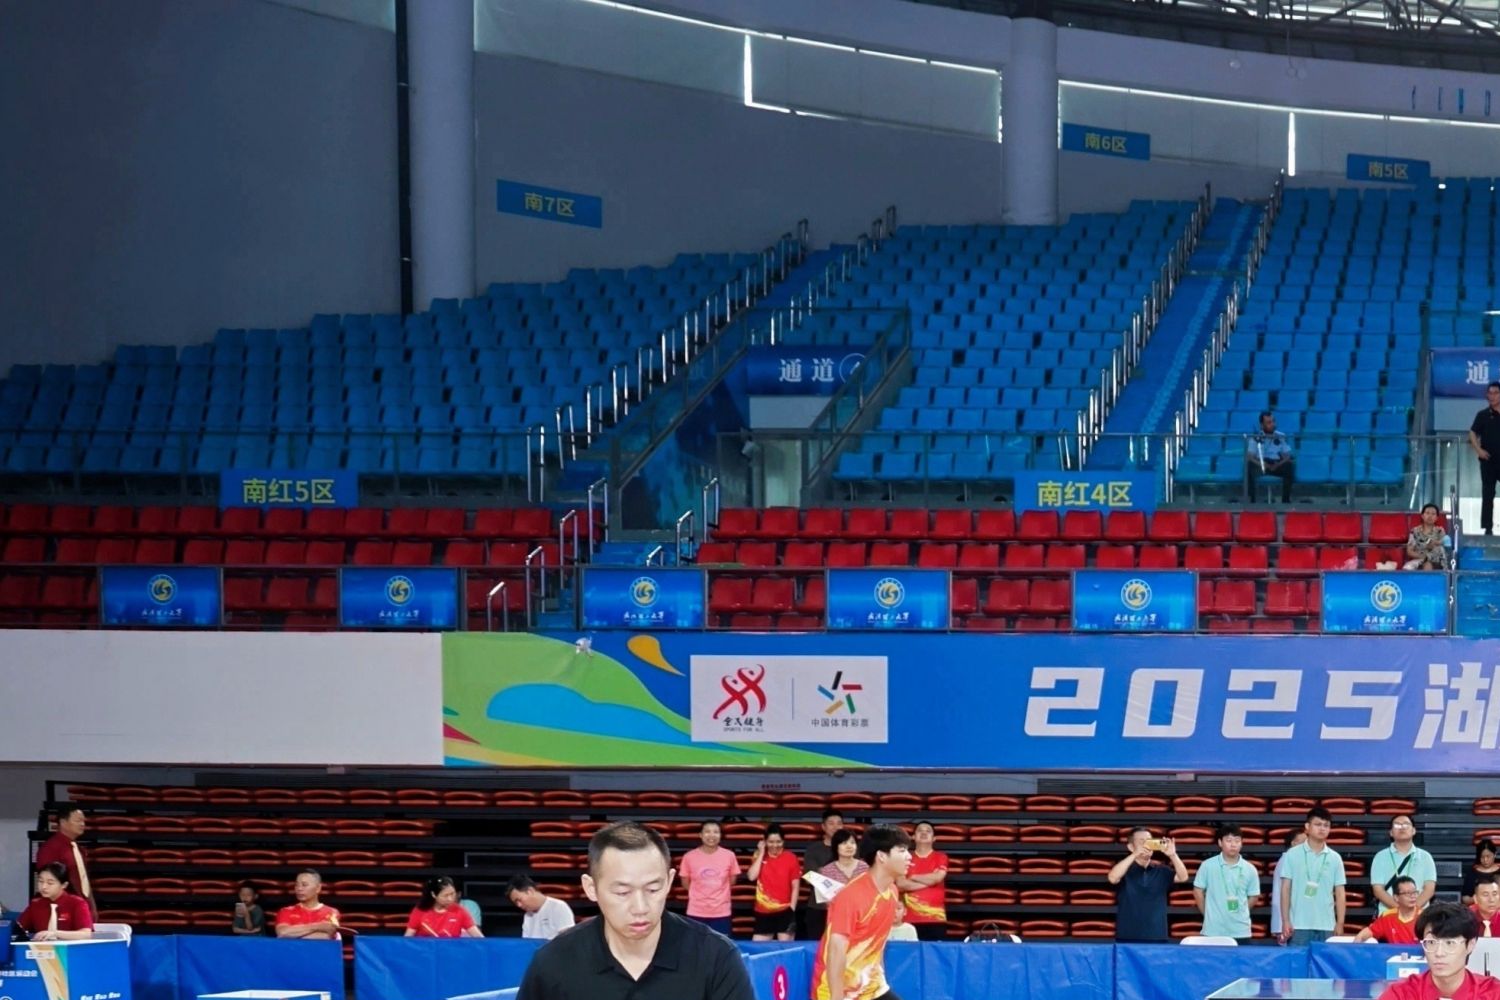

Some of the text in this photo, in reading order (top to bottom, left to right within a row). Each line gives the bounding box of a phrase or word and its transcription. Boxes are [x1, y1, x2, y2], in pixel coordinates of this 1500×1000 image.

[1083, 132, 1128, 154] 南6区
[1367, 160, 1409, 180] 南5区
[523, 191, 576, 219] 南7区
[242, 478, 337, 504] 南红5区
[1037, 480, 1133, 508] 南红4区
[811, 718, 869, 728] 中国体育彩票
